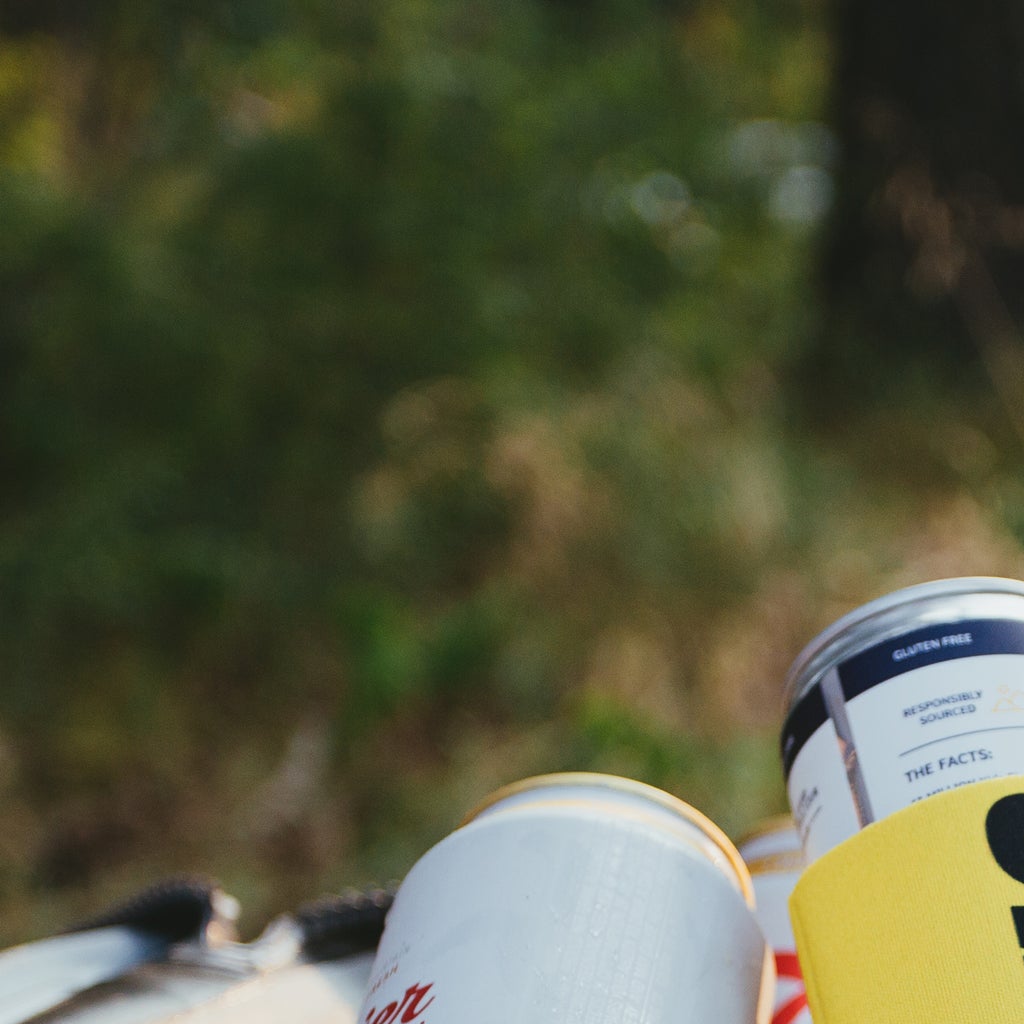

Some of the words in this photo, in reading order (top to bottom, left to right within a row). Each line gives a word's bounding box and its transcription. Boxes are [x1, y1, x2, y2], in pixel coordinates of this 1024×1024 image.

[892, 639, 940, 662] GLUTEN
[941, 633, 973, 646] FREE
[903, 689, 983, 718] RESPONSIBLY
[920, 704, 977, 725] SOURCED
[904, 762, 934, 783] THE
[938, 748, 993, 770] FACTS:
